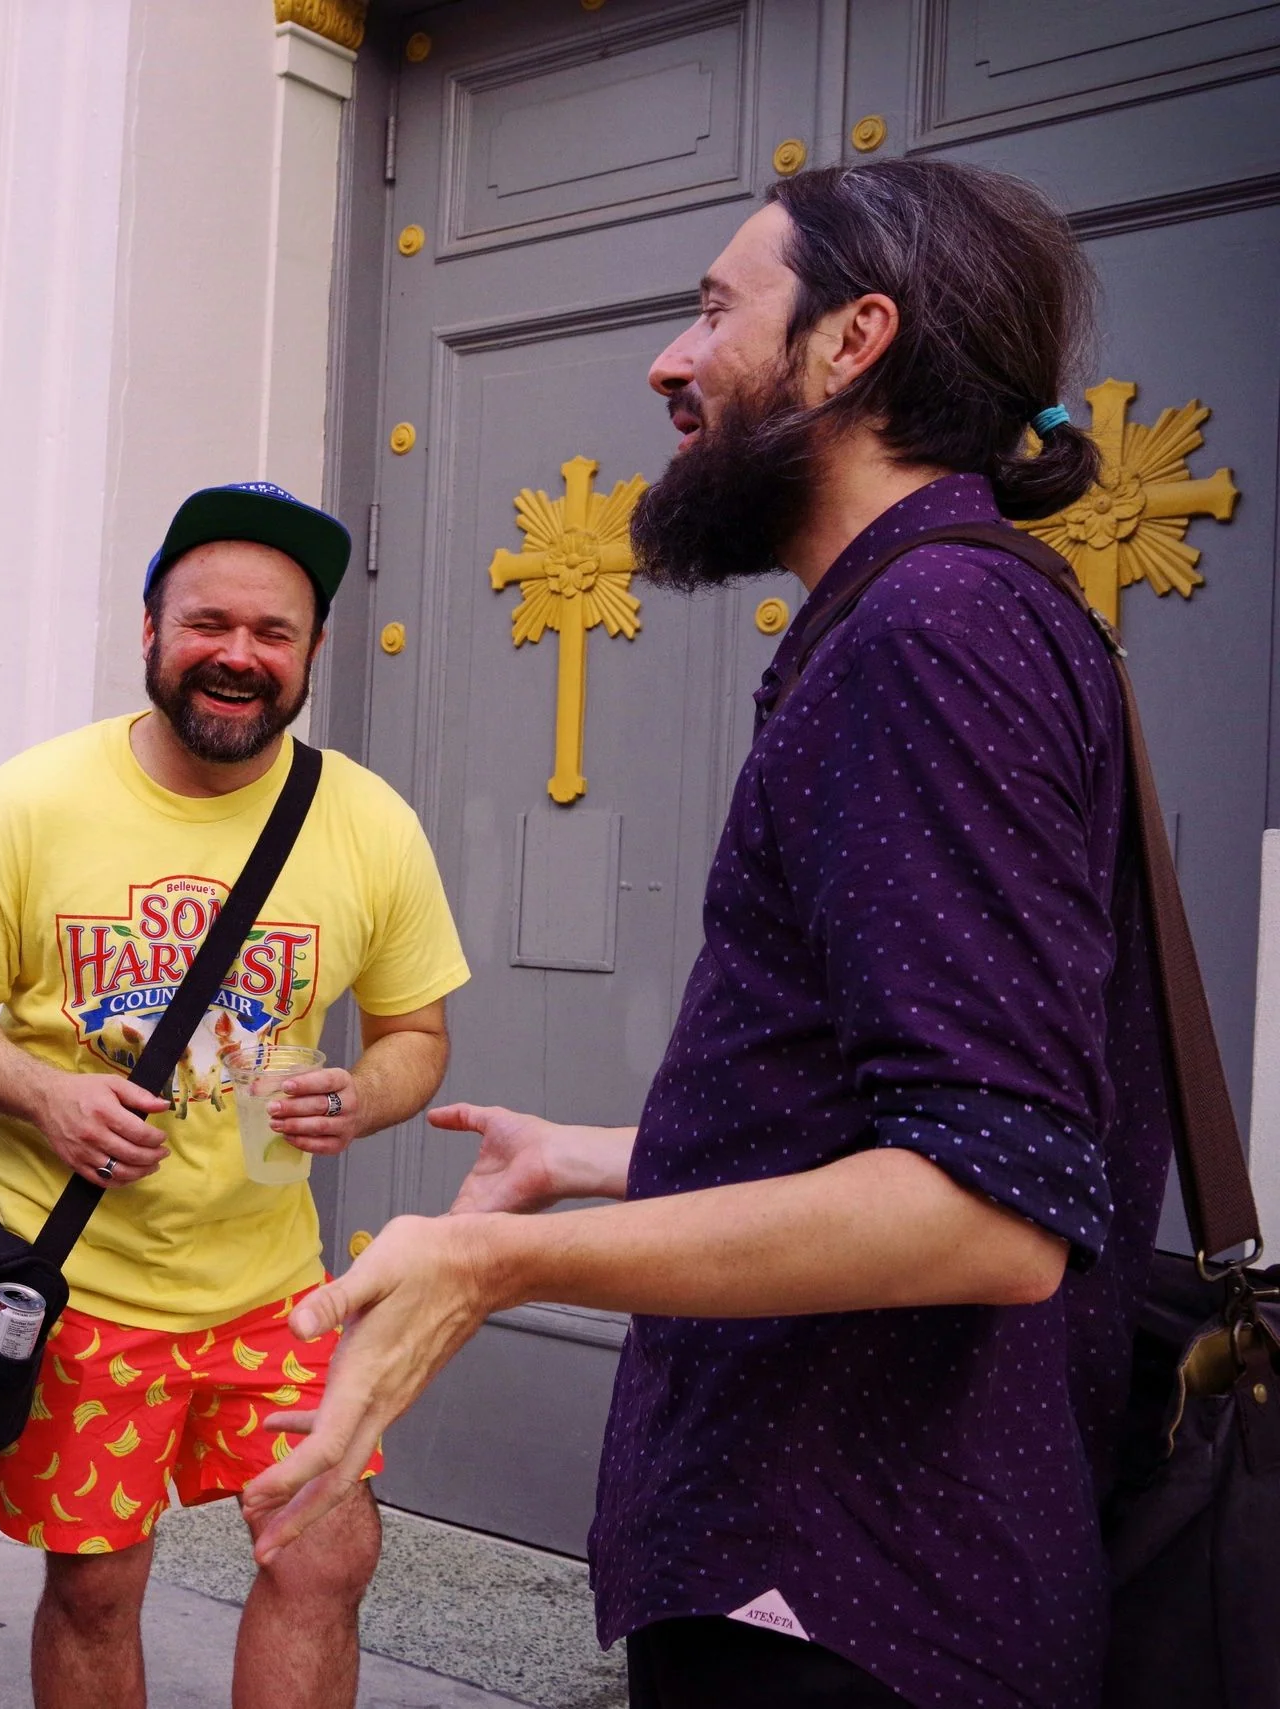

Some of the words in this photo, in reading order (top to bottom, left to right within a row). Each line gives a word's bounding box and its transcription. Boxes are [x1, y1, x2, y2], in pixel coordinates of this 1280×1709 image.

[166, 881, 216, 896] Bellevue's
[109, 987, 179, 1013] COUN
[214, 990, 252, 1017] AIR
